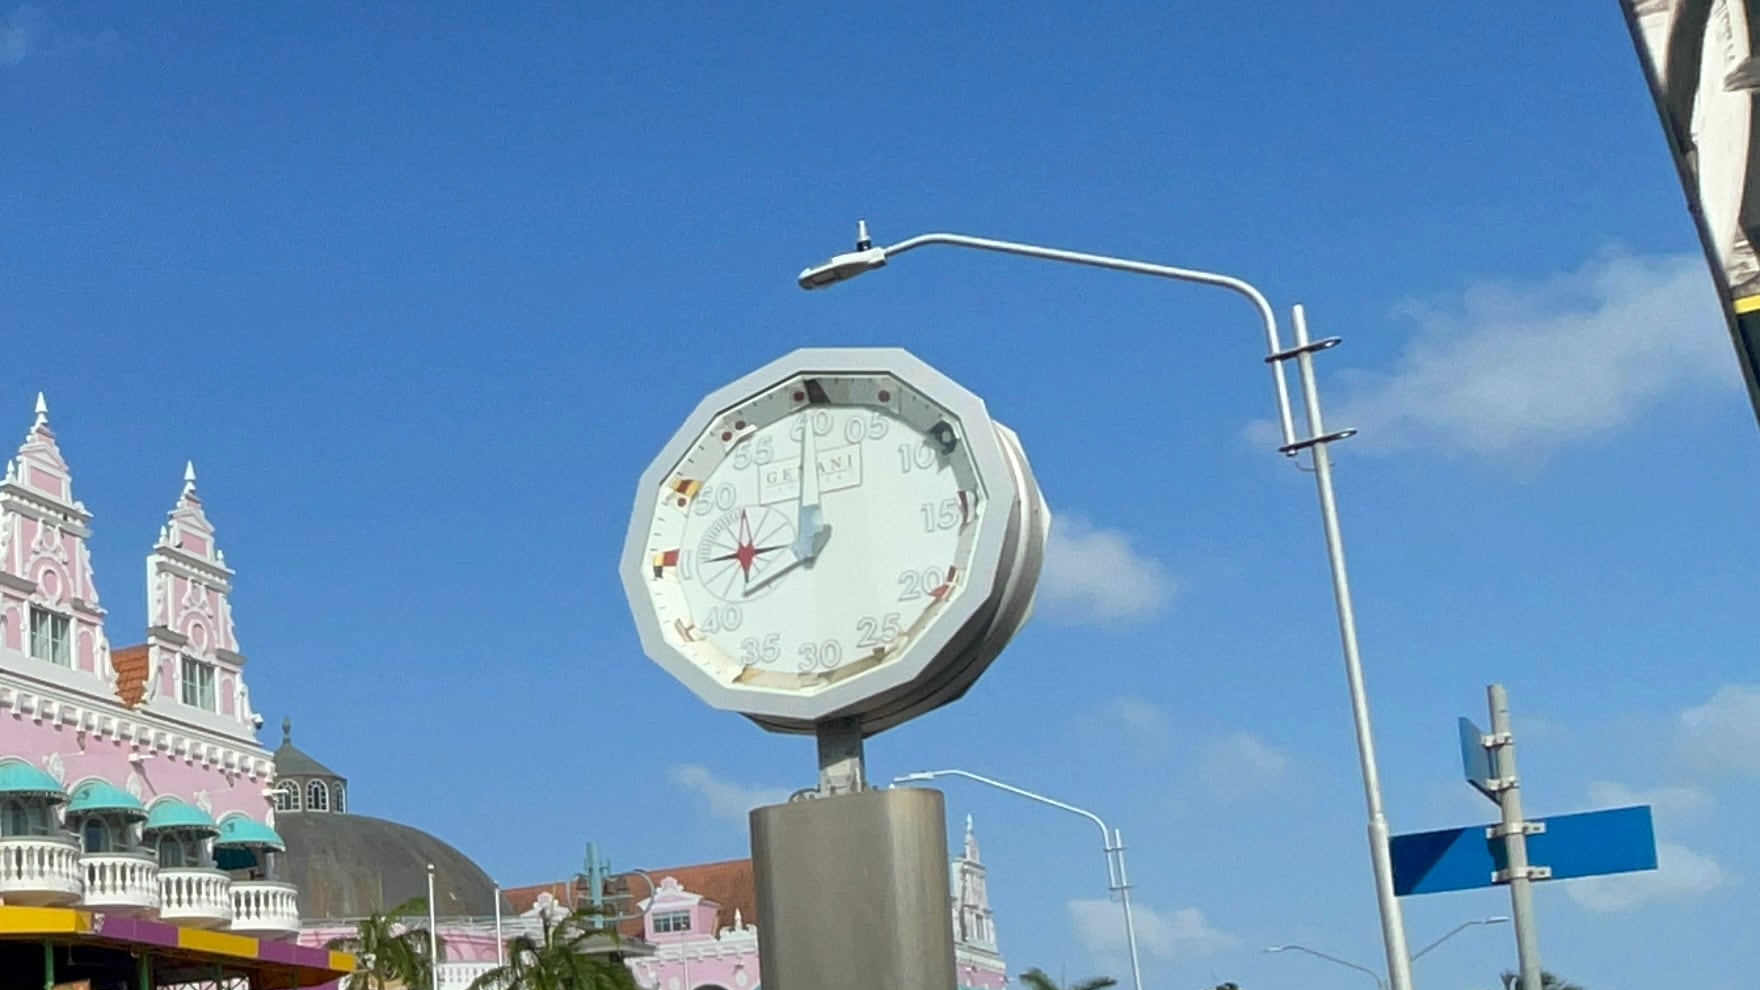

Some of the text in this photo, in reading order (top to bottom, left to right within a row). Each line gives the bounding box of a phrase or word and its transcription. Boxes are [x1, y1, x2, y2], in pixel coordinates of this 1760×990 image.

[844, 412, 889, 443] 05
[731, 437, 775, 471] 55
[898, 441, 937, 472] 10
[694, 481, 737, 517] 50
[921, 500, 961, 532] 15
[898, 566, 942, 602] 20
[701, 604, 743, 636] 40
[856, 612, 902, 648] 25
[739, 633, 782, 668] 35
[797, 638, 843, 673] 30
